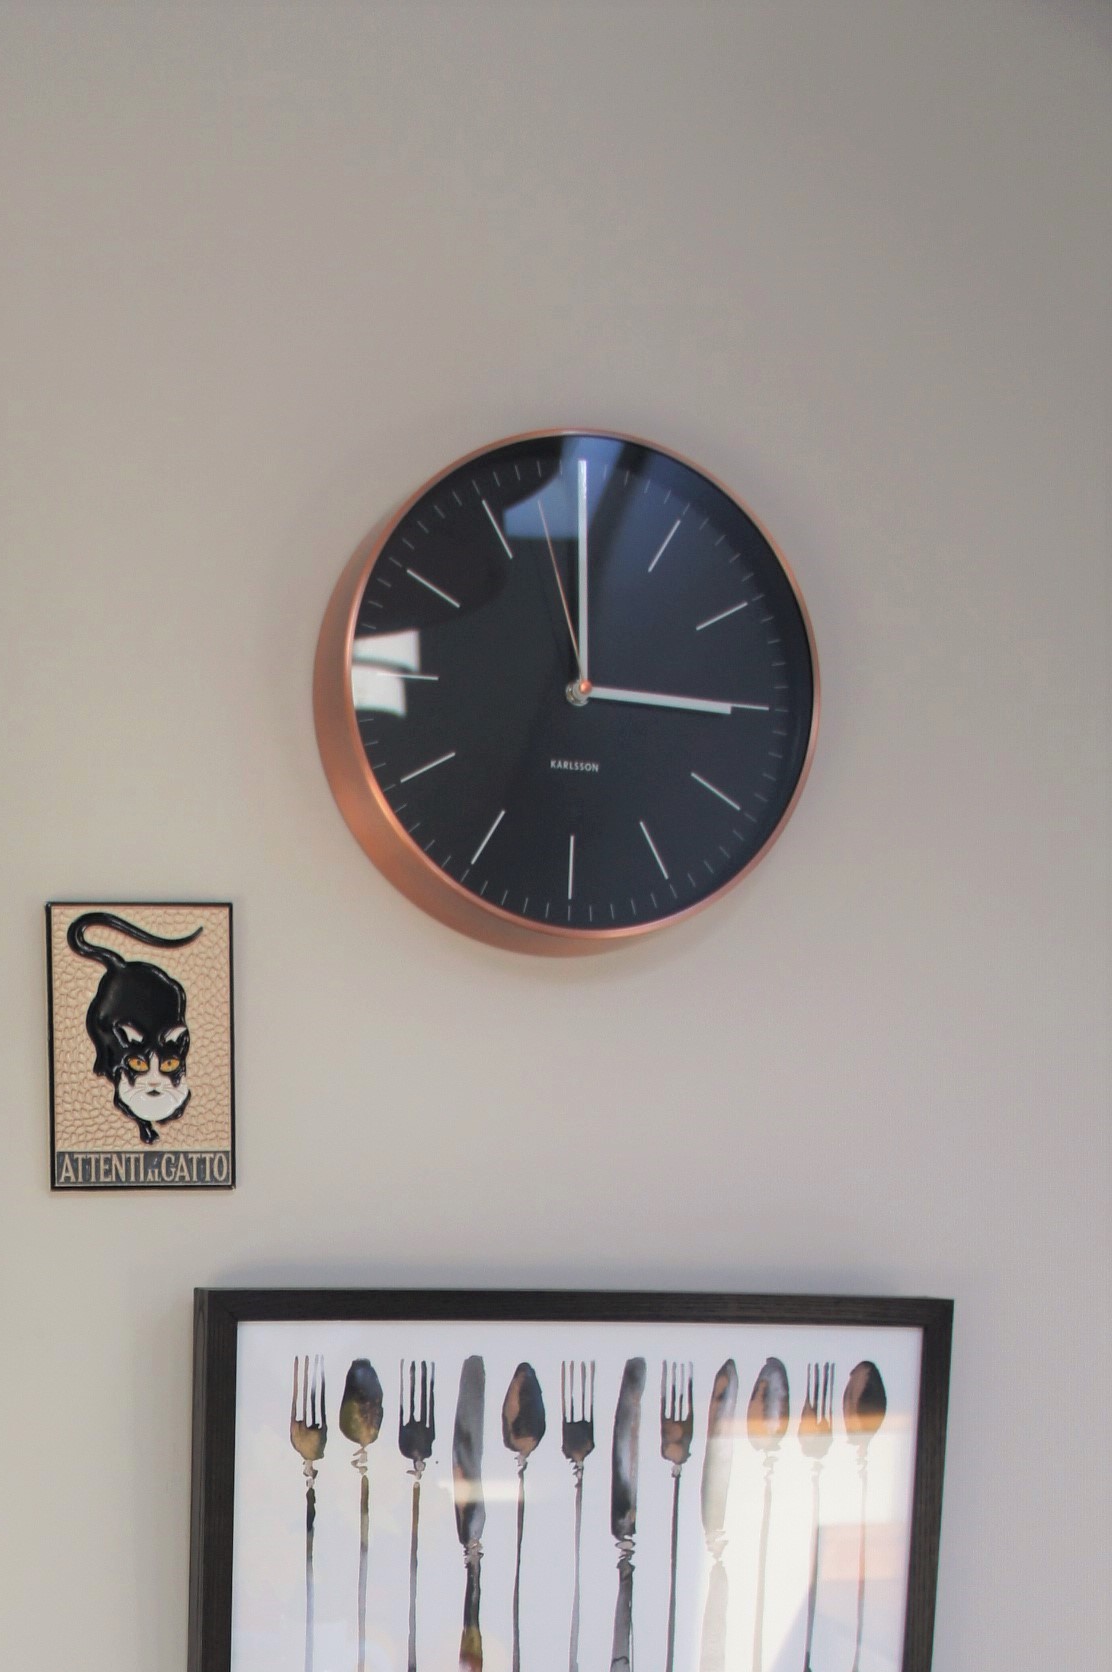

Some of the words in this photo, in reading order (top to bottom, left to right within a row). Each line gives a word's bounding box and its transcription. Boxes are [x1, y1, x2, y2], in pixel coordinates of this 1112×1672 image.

[550, 760, 599, 772] KARLSSON
[59, 1152, 144, 1183] ATTENTI
[147, 1168, 162, 1182] AL
[161, 1152, 228, 1182] GATTO
